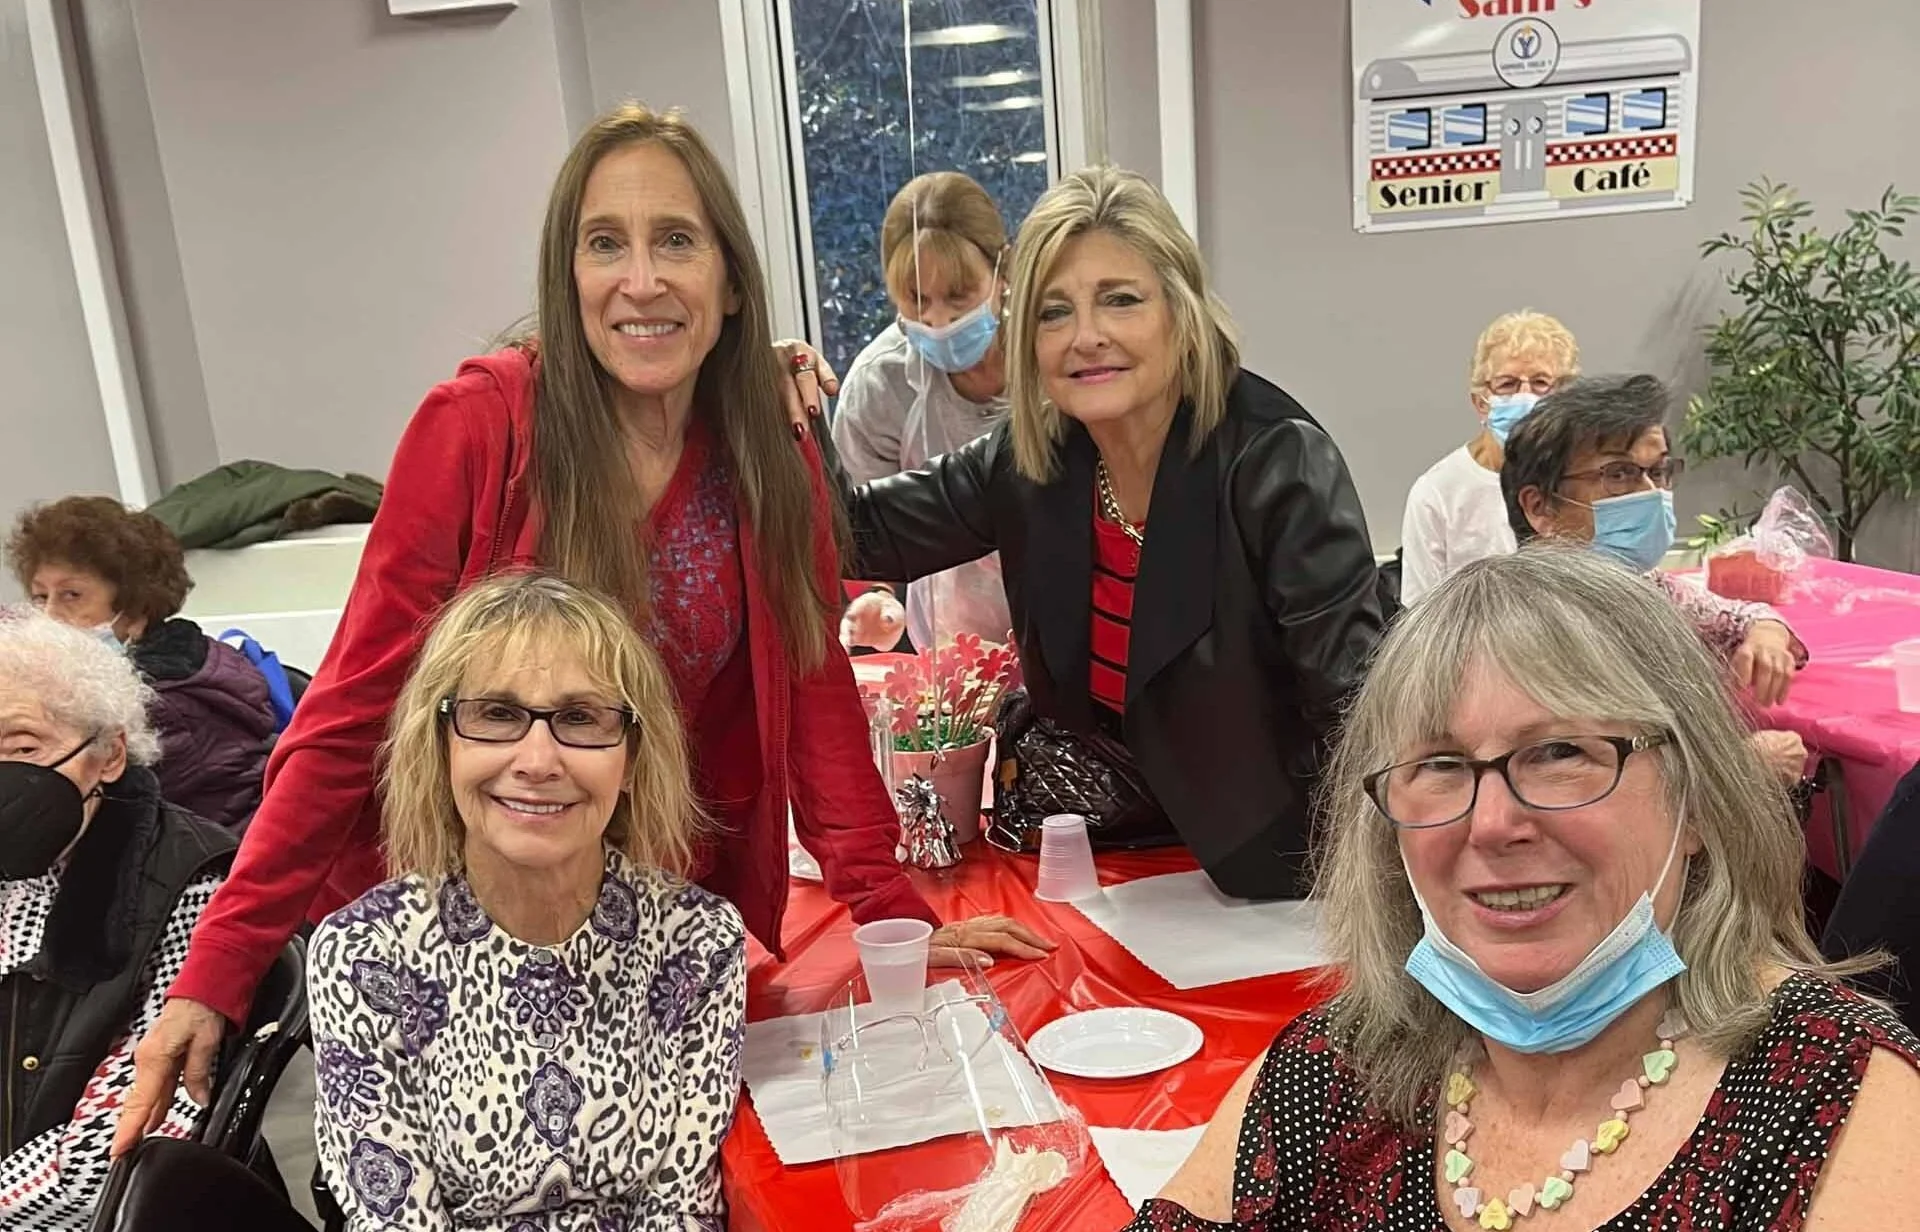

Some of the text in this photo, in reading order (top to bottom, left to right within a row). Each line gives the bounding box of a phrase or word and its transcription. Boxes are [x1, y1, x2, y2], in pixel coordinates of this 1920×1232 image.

[1459, 0, 1592, 18] Sam
[1379, 162, 1651, 209] Senior Café
